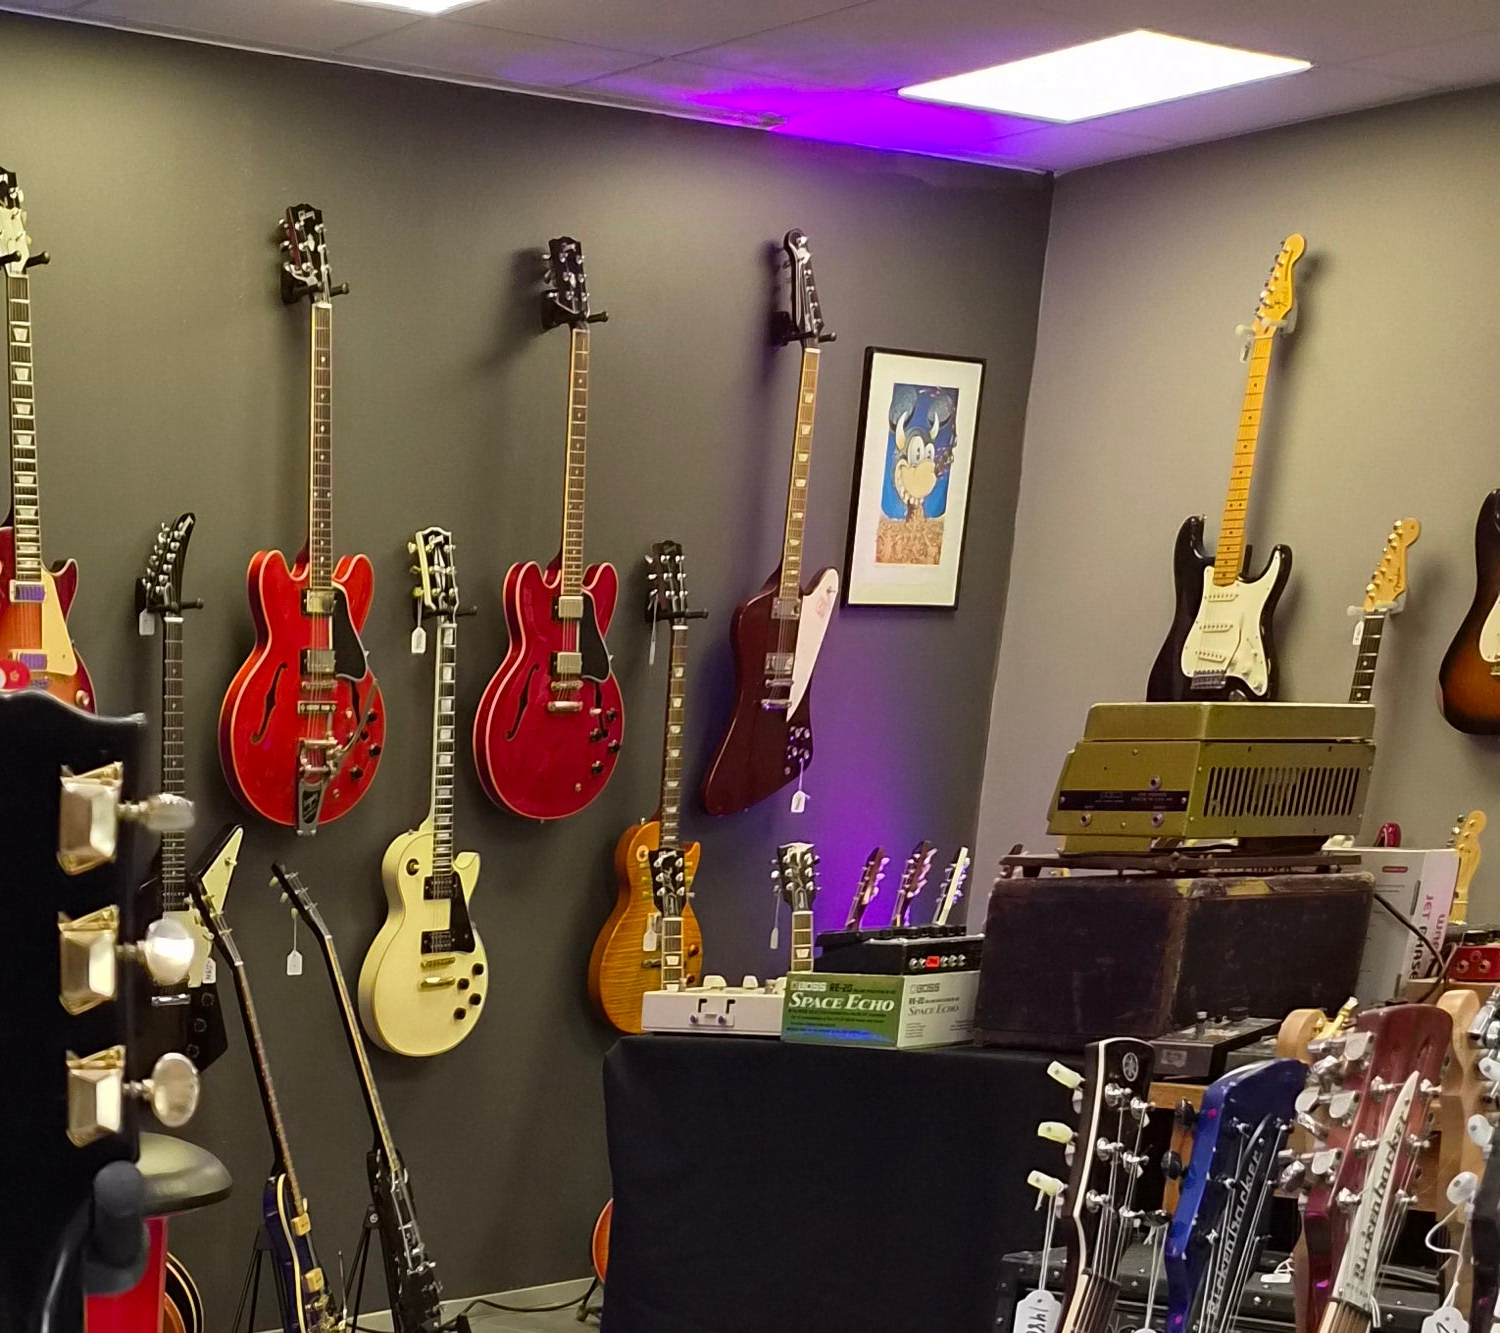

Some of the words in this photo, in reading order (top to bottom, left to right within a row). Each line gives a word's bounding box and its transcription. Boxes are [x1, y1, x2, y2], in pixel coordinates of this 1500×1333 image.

[788, 991, 842, 1009] SPACE
[843, 993, 896, 1012] ECHO
[793, 981, 827, 992] BOSS
[1205, 1149, 1263, 1322] Rickenbacker
[1353, 1115, 1407, 1283] Rickenbacker
